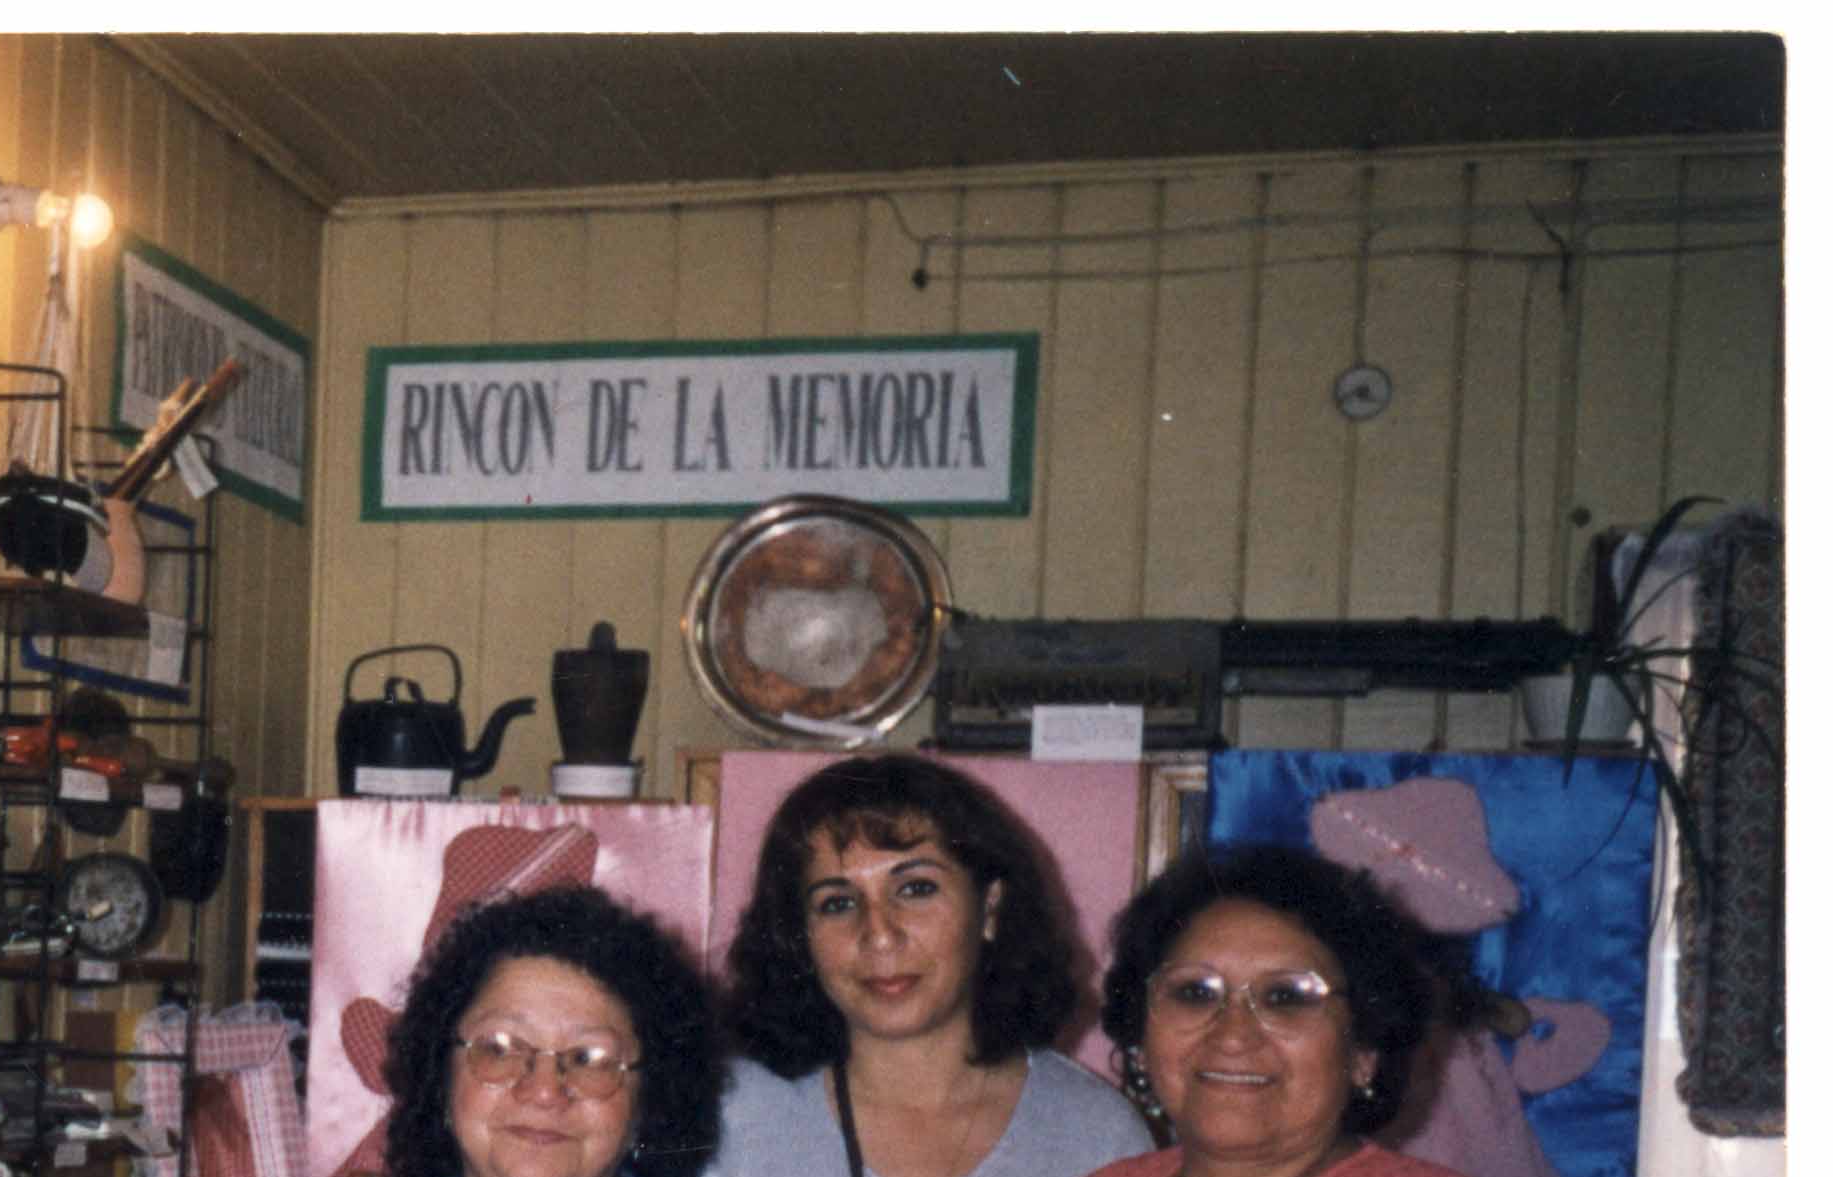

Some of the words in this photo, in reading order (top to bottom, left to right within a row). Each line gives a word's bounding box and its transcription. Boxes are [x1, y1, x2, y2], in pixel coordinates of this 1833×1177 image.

[399, 381, 559, 475] RINCON
[587, 378, 647, 472] DE
[673, 374, 731, 471] LA
[766, 370, 985, 470] MEMORIA
